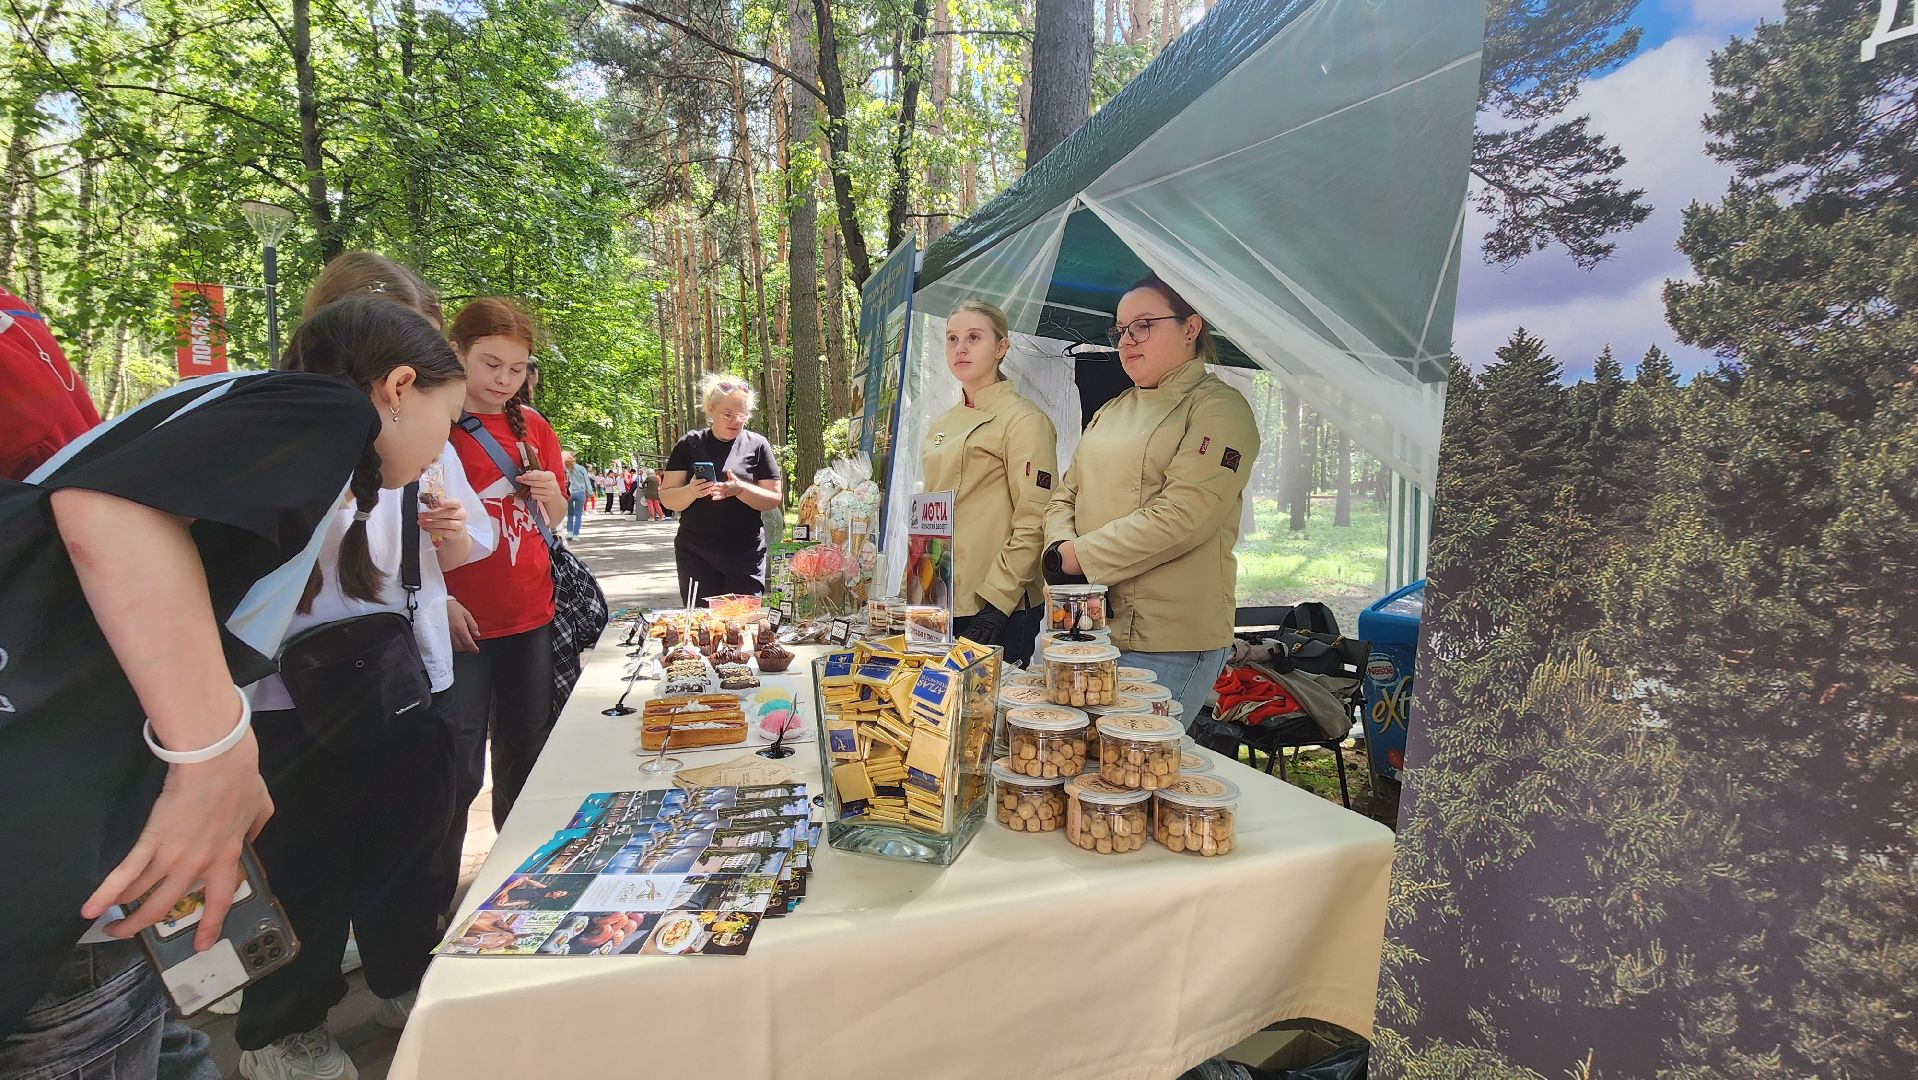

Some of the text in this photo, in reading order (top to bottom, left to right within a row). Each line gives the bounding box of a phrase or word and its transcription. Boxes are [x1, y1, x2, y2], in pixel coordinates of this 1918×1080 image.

[191, 303, 212, 366] ПОБЕД
[916, 679, 946, 695] ATLAS
[1371, 675, 1413, 734] eXt
